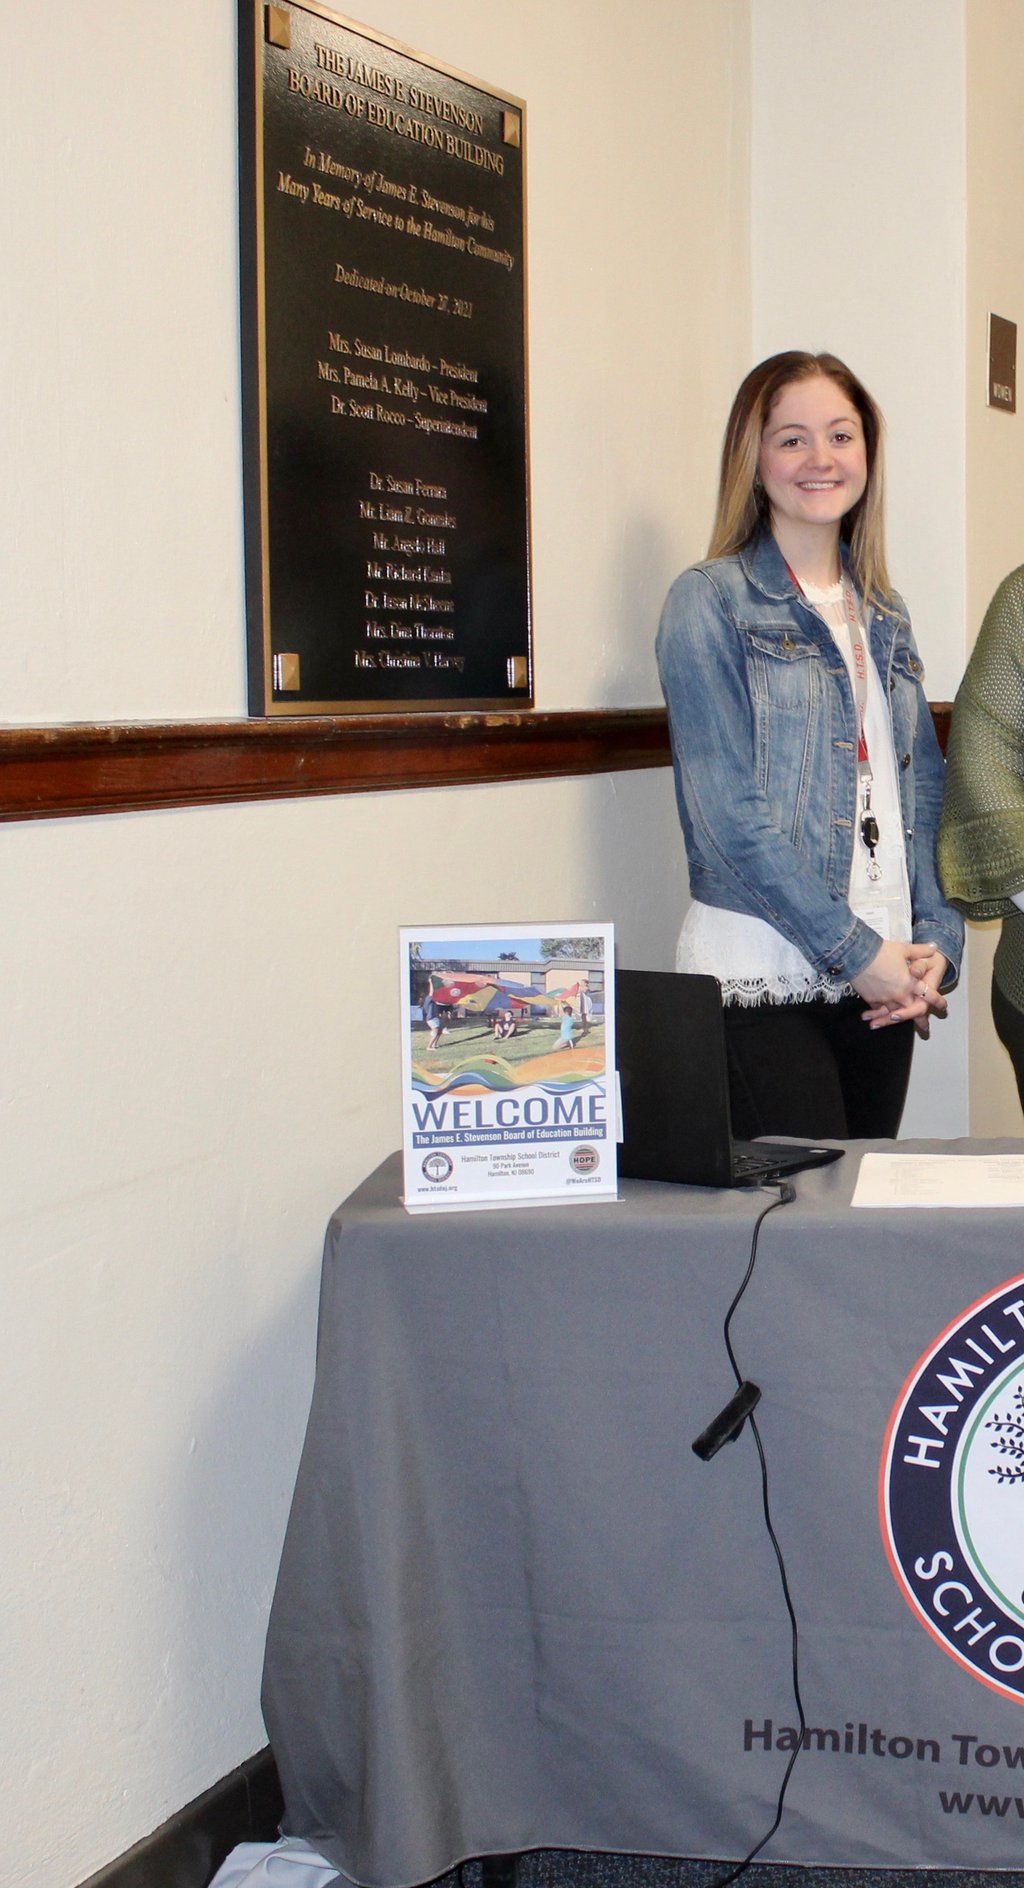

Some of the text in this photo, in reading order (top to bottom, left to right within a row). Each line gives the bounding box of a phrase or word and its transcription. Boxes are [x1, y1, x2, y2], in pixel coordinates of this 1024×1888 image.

[315, 43, 347, 77] THE
[347, 57, 392, 97] JAMES
[409, 85, 483, 135] STEVENSON
[288, 67, 504, 176] BOARD OF EDUCATION BUILDING
[303, 146, 316, 169] In
[318, 151, 362, 189] Memory
[362, 170, 377, 193] of
[376, 172, 407, 200] James
[420, 188, 466, 222] Stevenson
[277, 170, 514, 272] Many Years of Service to the Hamilton Community
[335, 263, 385, 294] Dedicated
[386, 283, 398, 299] on
[399, 283, 435, 308] October
[328, 331, 352, 355] Mrs.
[354, 338, 382, 362] Susan
[384, 345, 431, 373] Lombardo
[440, 358, 478, 383] President
[317, 360, 341, 383] Mrs.
[343, 366, 379, 391] Pamela
[380, 375, 392, 394] A.
[394, 377, 419, 403] Kelly
[428, 384, 449, 405] Vice
[450, 389, 488, 413] President
[331, 394, 347, 415] Dr.
[349, 399, 374, 420] Scott
[376, 403, 406, 426] Rocco
[414, 411, 478, 439] Superintendent
[369, 472, 384, 491] Dr.
[386, 474, 414, 495] Susan
[412, 1095, 607, 1131] WELCOME
[416, 1127, 603, 1145] The James E. Stevenson Board of Education Building
[461, 1151, 560, 1163] Hamilton Township School District
[573, 1156, 596, 1164] HOPE
[743, 1719, 941, 1763] Hamilton
